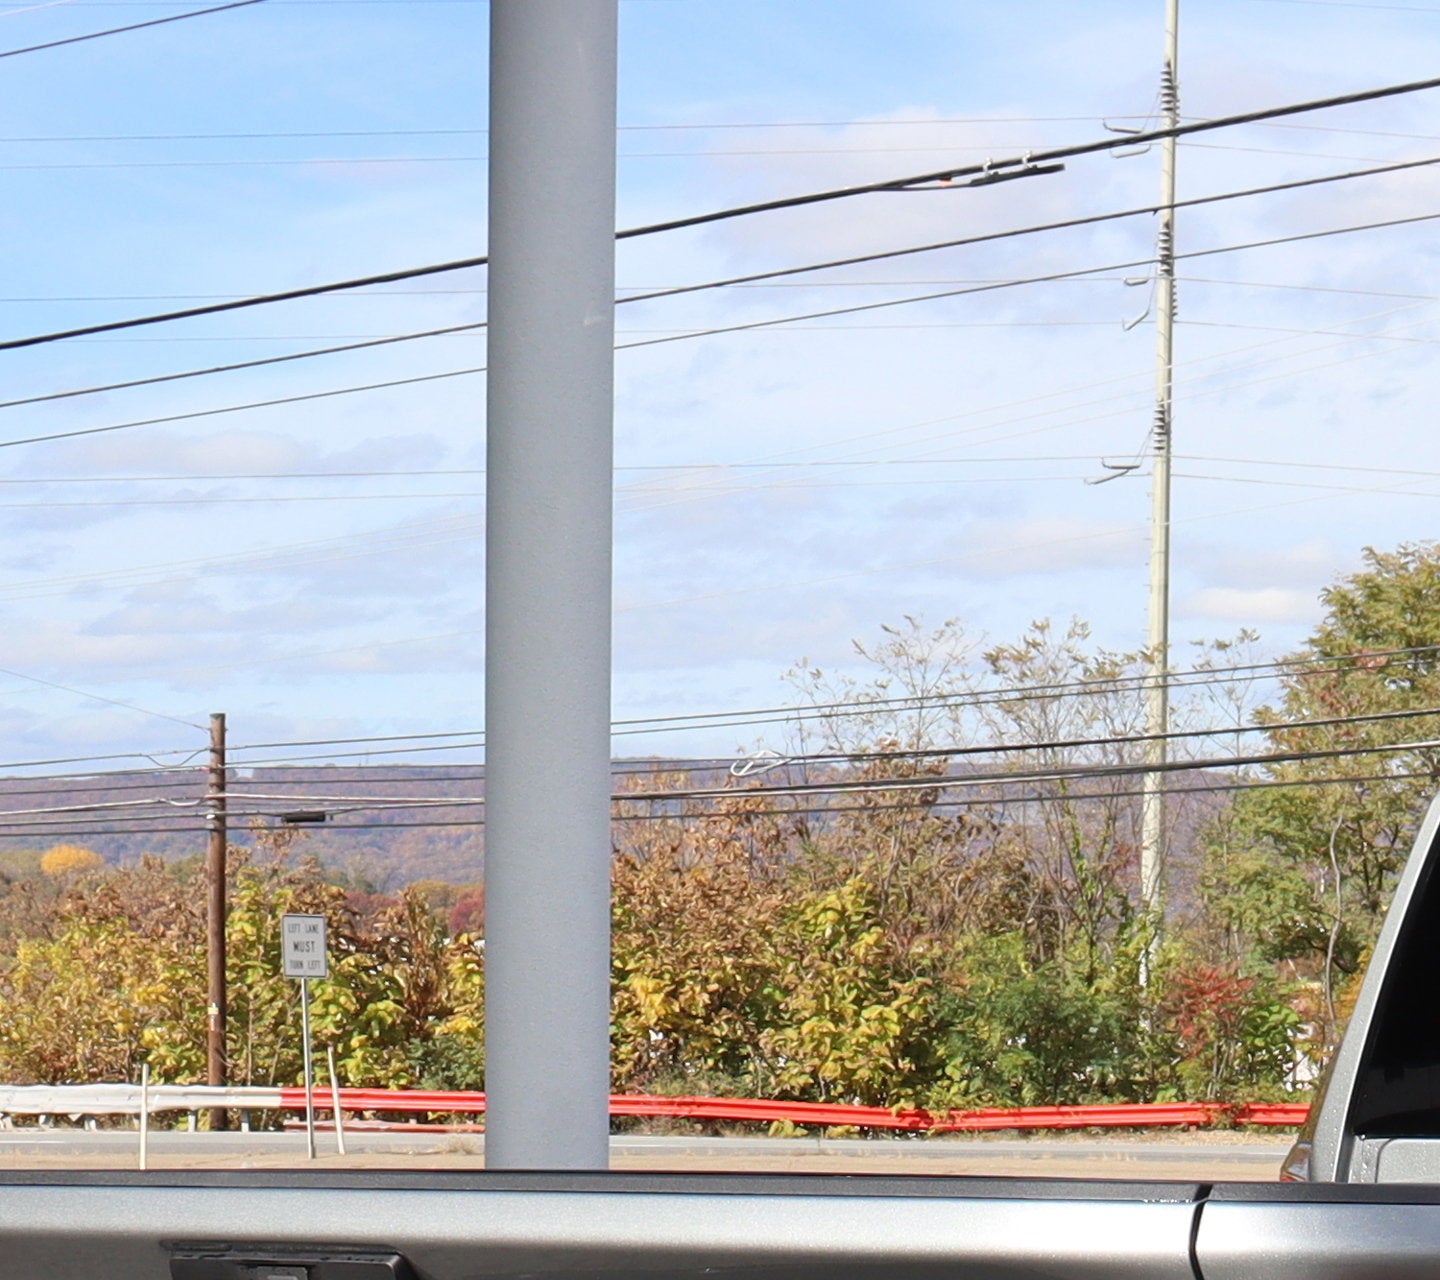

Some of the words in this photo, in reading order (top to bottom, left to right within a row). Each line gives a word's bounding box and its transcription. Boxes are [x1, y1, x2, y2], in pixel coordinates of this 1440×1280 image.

[287, 923, 301, 933] LEFT
[305, 923, 320, 934] LANE
[293, 940, 316, 953] MUST
[307, 960, 321, 970] LEFT
